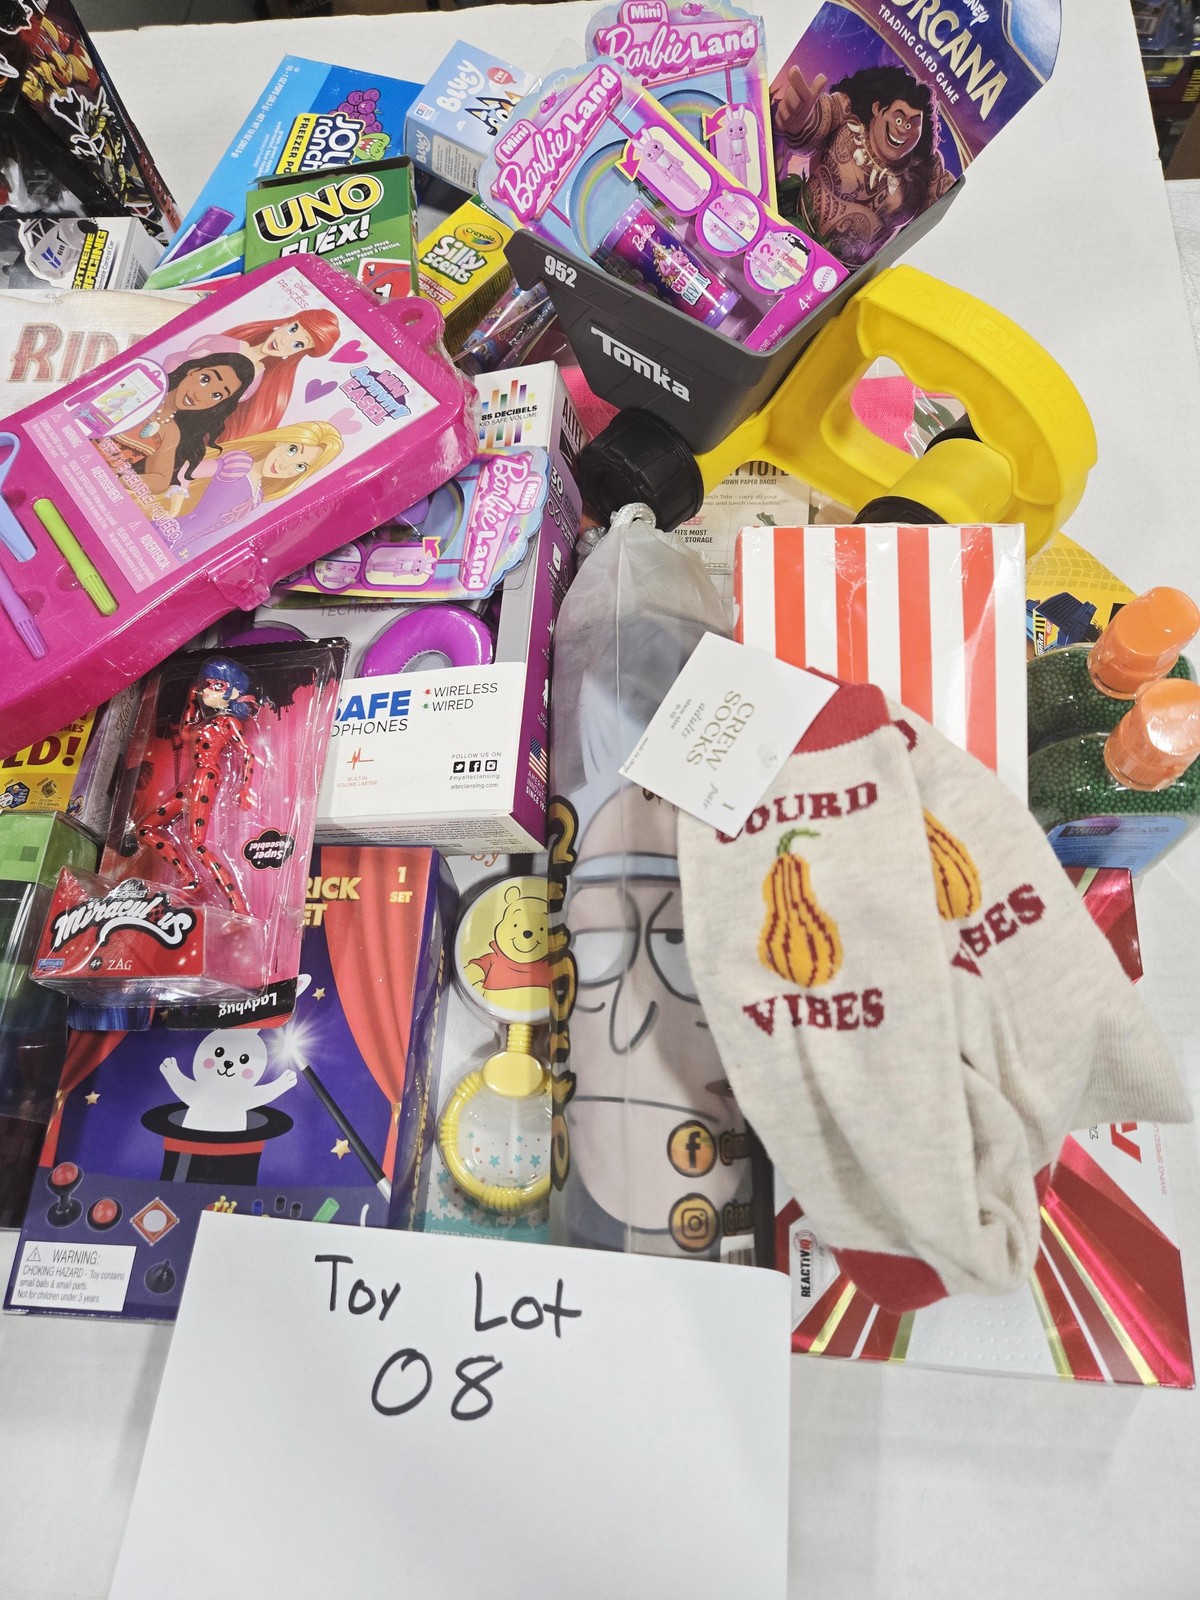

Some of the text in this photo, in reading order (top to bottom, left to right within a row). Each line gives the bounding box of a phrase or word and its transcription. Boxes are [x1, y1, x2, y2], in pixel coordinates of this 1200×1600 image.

[631, 3, 661, 20] Mini
[877, 4, 960, 105] TRADING CARD GAME
[290, 116, 312, 158] FREEZER
[502, 123, 530, 157] Mini
[253, 174, 384, 243] UNO
[466, 228, 497, 243] Crayola
[434, 236, 485, 269] Silly
[97, 268, 106, 289] emote
[423, 253, 471, 283] scents
[545, 254, 578, 289] 952
[817, 266, 834, 290] MATTEL
[276, 279, 309, 309] PRINCESS
[682, 275, 710, 305] REVAL
[799, 292, 814, 311] 4+
[9, 322, 143, 384] RID
[591, 326, 690, 402] Tonka
[340, 378, 386, 426] EASEL
[350, 366, 412, 420] ACTIVITY
[481, 405, 538, 422] 85 DECIBELS
[493, 417, 507, 425] SAFE
[509, 411, 538, 422] VOLUME
[517, 480, 538, 511] Mini
[434, 683, 499, 698] WIRELESS
[432, 698, 473, 712] WIRED
[680, 702, 705, 738] adults
[686, 690, 741, 766] SOCKS
[707, 701, 755, 772] CREW
[449, 773, 500, 781] #myalteclansing
[450, 782, 499, 790] alteclansing.com
[526, 786, 539, 805] SINCE
[249, 841, 288, 853] oseable!
[253, 848, 285, 860] Super
[397, 866, 407, 884] 1
[389, 890, 413, 904] SET
[107, 958, 133, 971] ZAG
[218, 992, 277, 1018] Ladybug
[742, 988, 884, 1036] VIBES
[1153, 1134, 1164, 1164] SPEED
[1157, 1165, 1168, 1196] SWING
[53, 1249, 100, 1266] WARNING:
[20, 1279, 88, 1292] small balls & small parts.
[23, 1265, 54, 1277] CHOKING
[55, 1266, 83, 1278] HAZARD
[89, 1270, 100, 1281] Toy
[100, 1271, 125, 1280] contains
[17, 1290, 101, 1305] Not for children under 3 years.
[314, 1254, 582, 1338] Toy Lot
